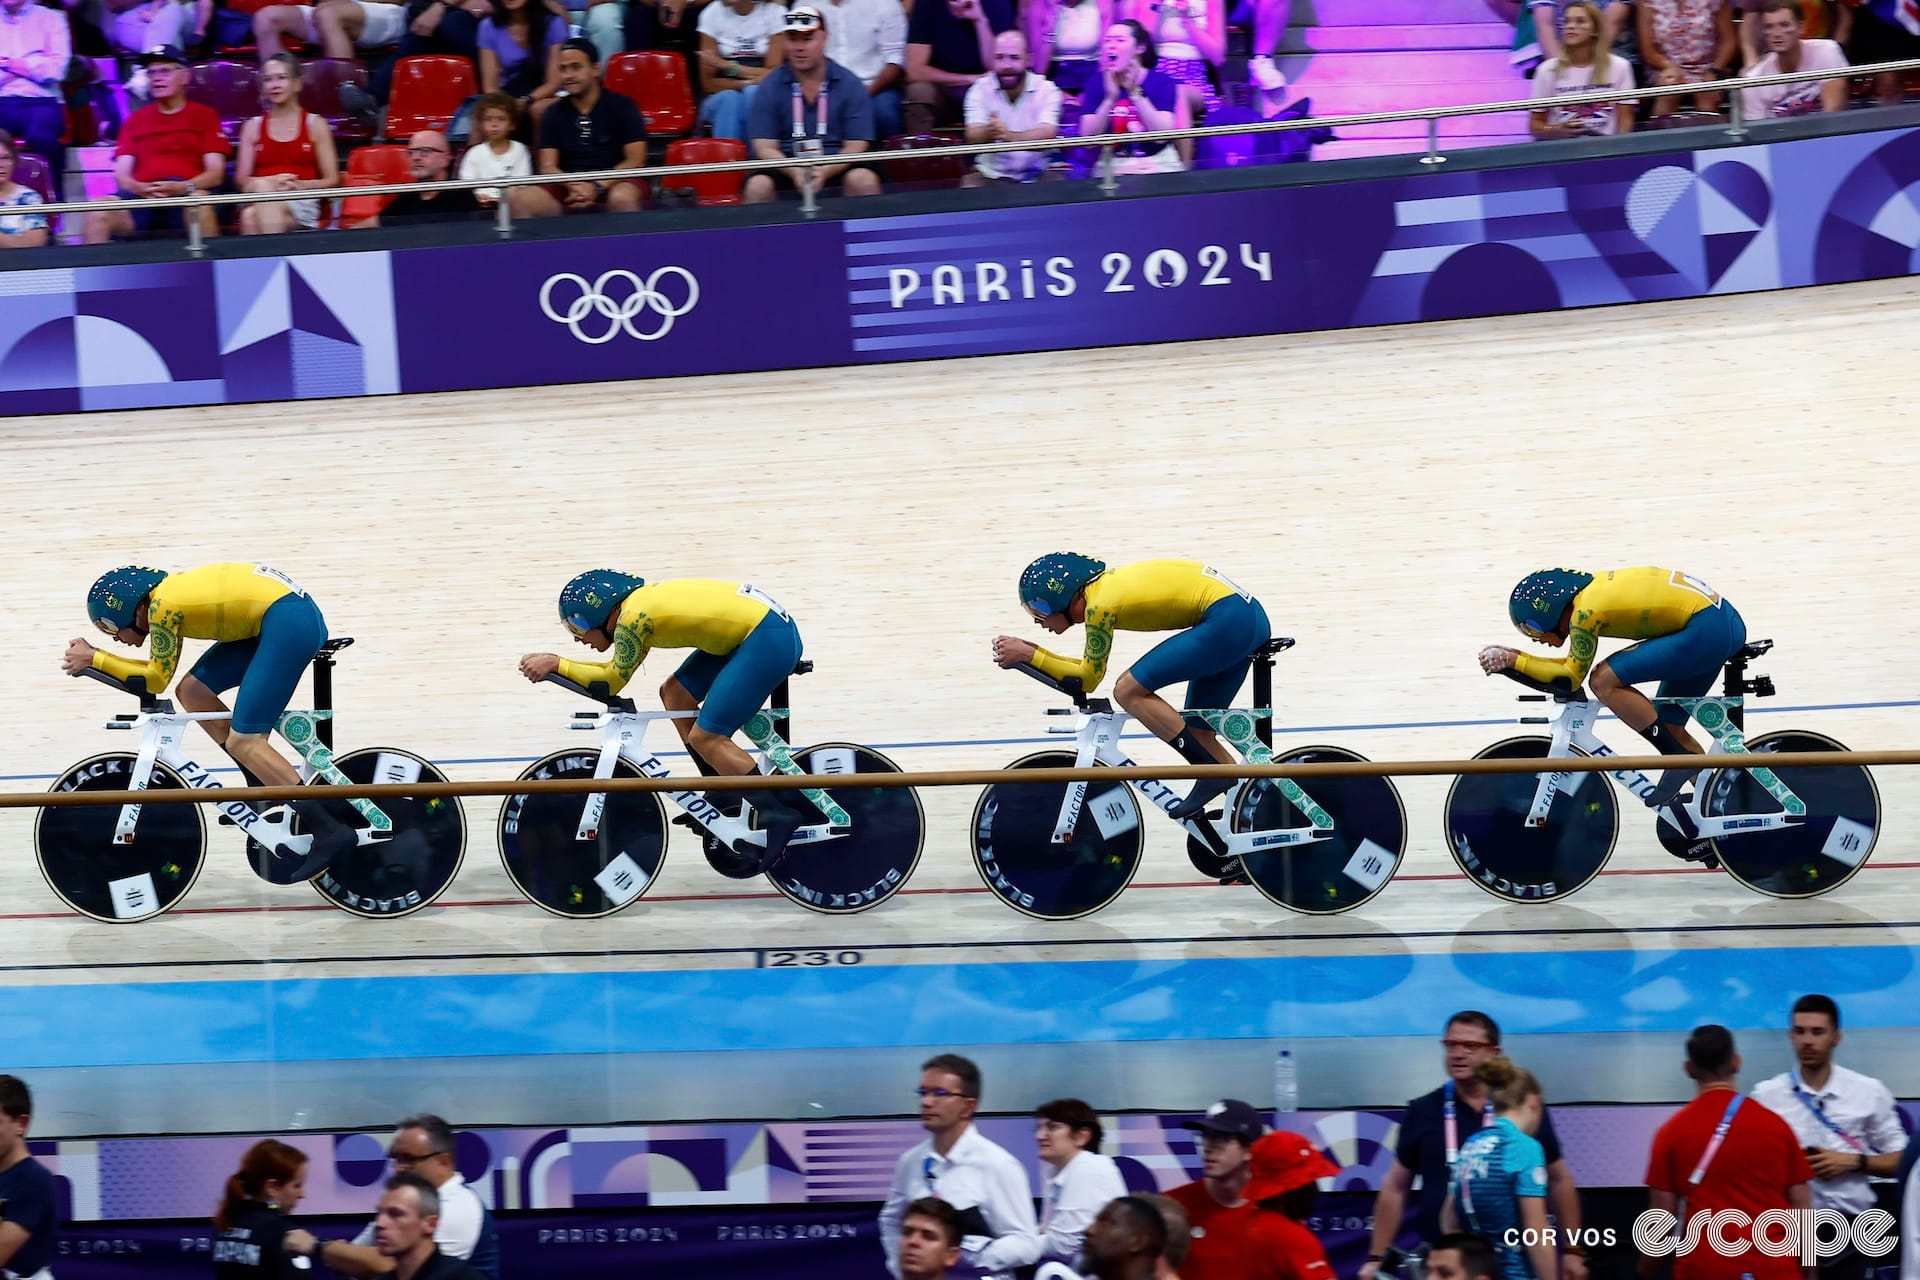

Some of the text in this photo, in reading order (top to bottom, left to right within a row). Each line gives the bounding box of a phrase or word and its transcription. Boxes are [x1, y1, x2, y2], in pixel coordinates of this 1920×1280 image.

[1101, 243, 1273, 291] 2024
[60, 760, 122, 793] LACK
[1543, 771, 1562, 807] FACTO
[505, 756, 596, 834] BLAK INC
[1067, 784, 1086, 826] FACTOR
[785, 867, 901, 907] BLACK INC
[980, 845, 1035, 908] BLACK
[1480, 868, 1557, 897] BLACK
[346, 890, 422, 911] BLACK
[769, 951, 862, 966] 230
[614, 1227, 678, 1242] 2024
[793, 1224, 857, 1239] 2024
[1330, 1216, 1375, 1230] 202
